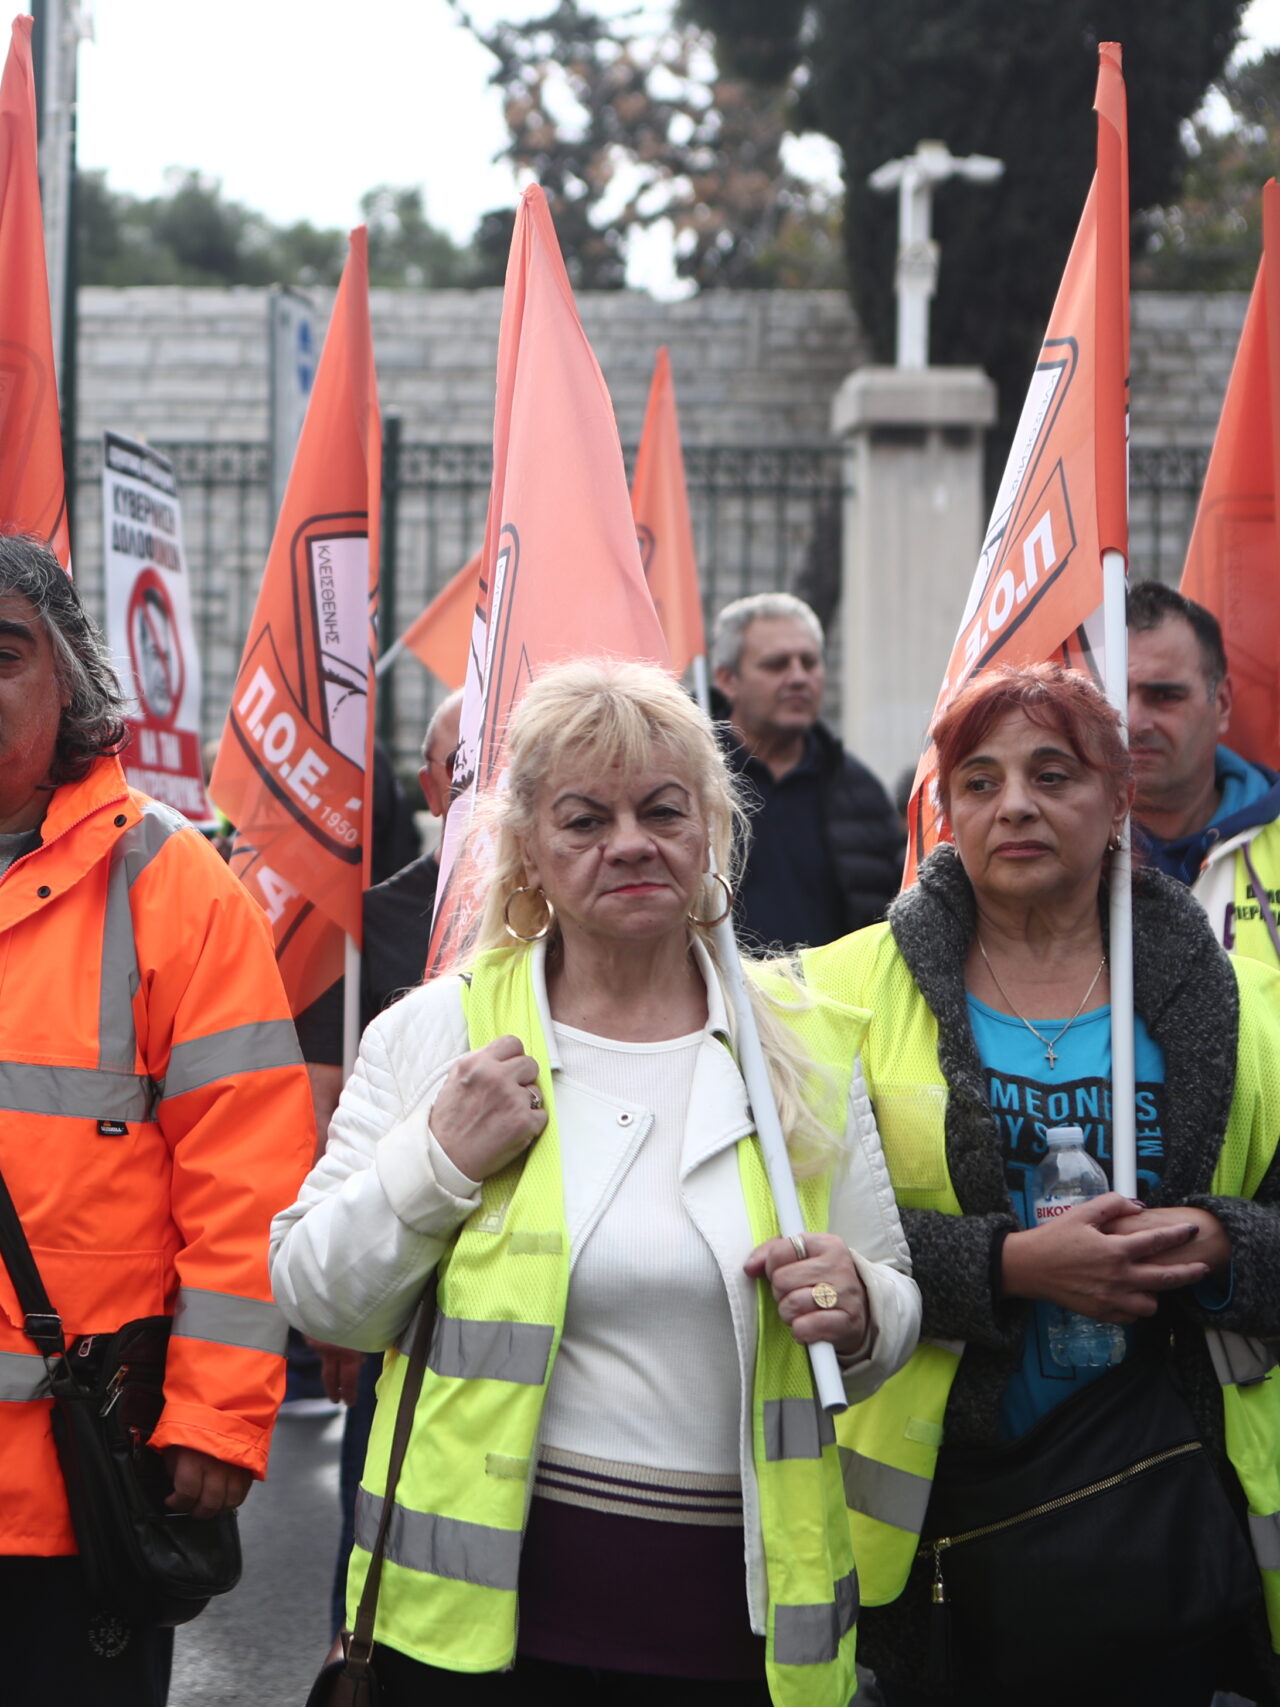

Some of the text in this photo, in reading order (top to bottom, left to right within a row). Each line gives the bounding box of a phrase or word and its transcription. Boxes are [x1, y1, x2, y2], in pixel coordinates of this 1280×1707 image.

[112, 520, 181, 573] ΔΟΛΟΦ
[317, 545, 341, 645] ΚΛΕΙΣΘΕΝΗΣ
[320, 805, 359, 844] 1950
